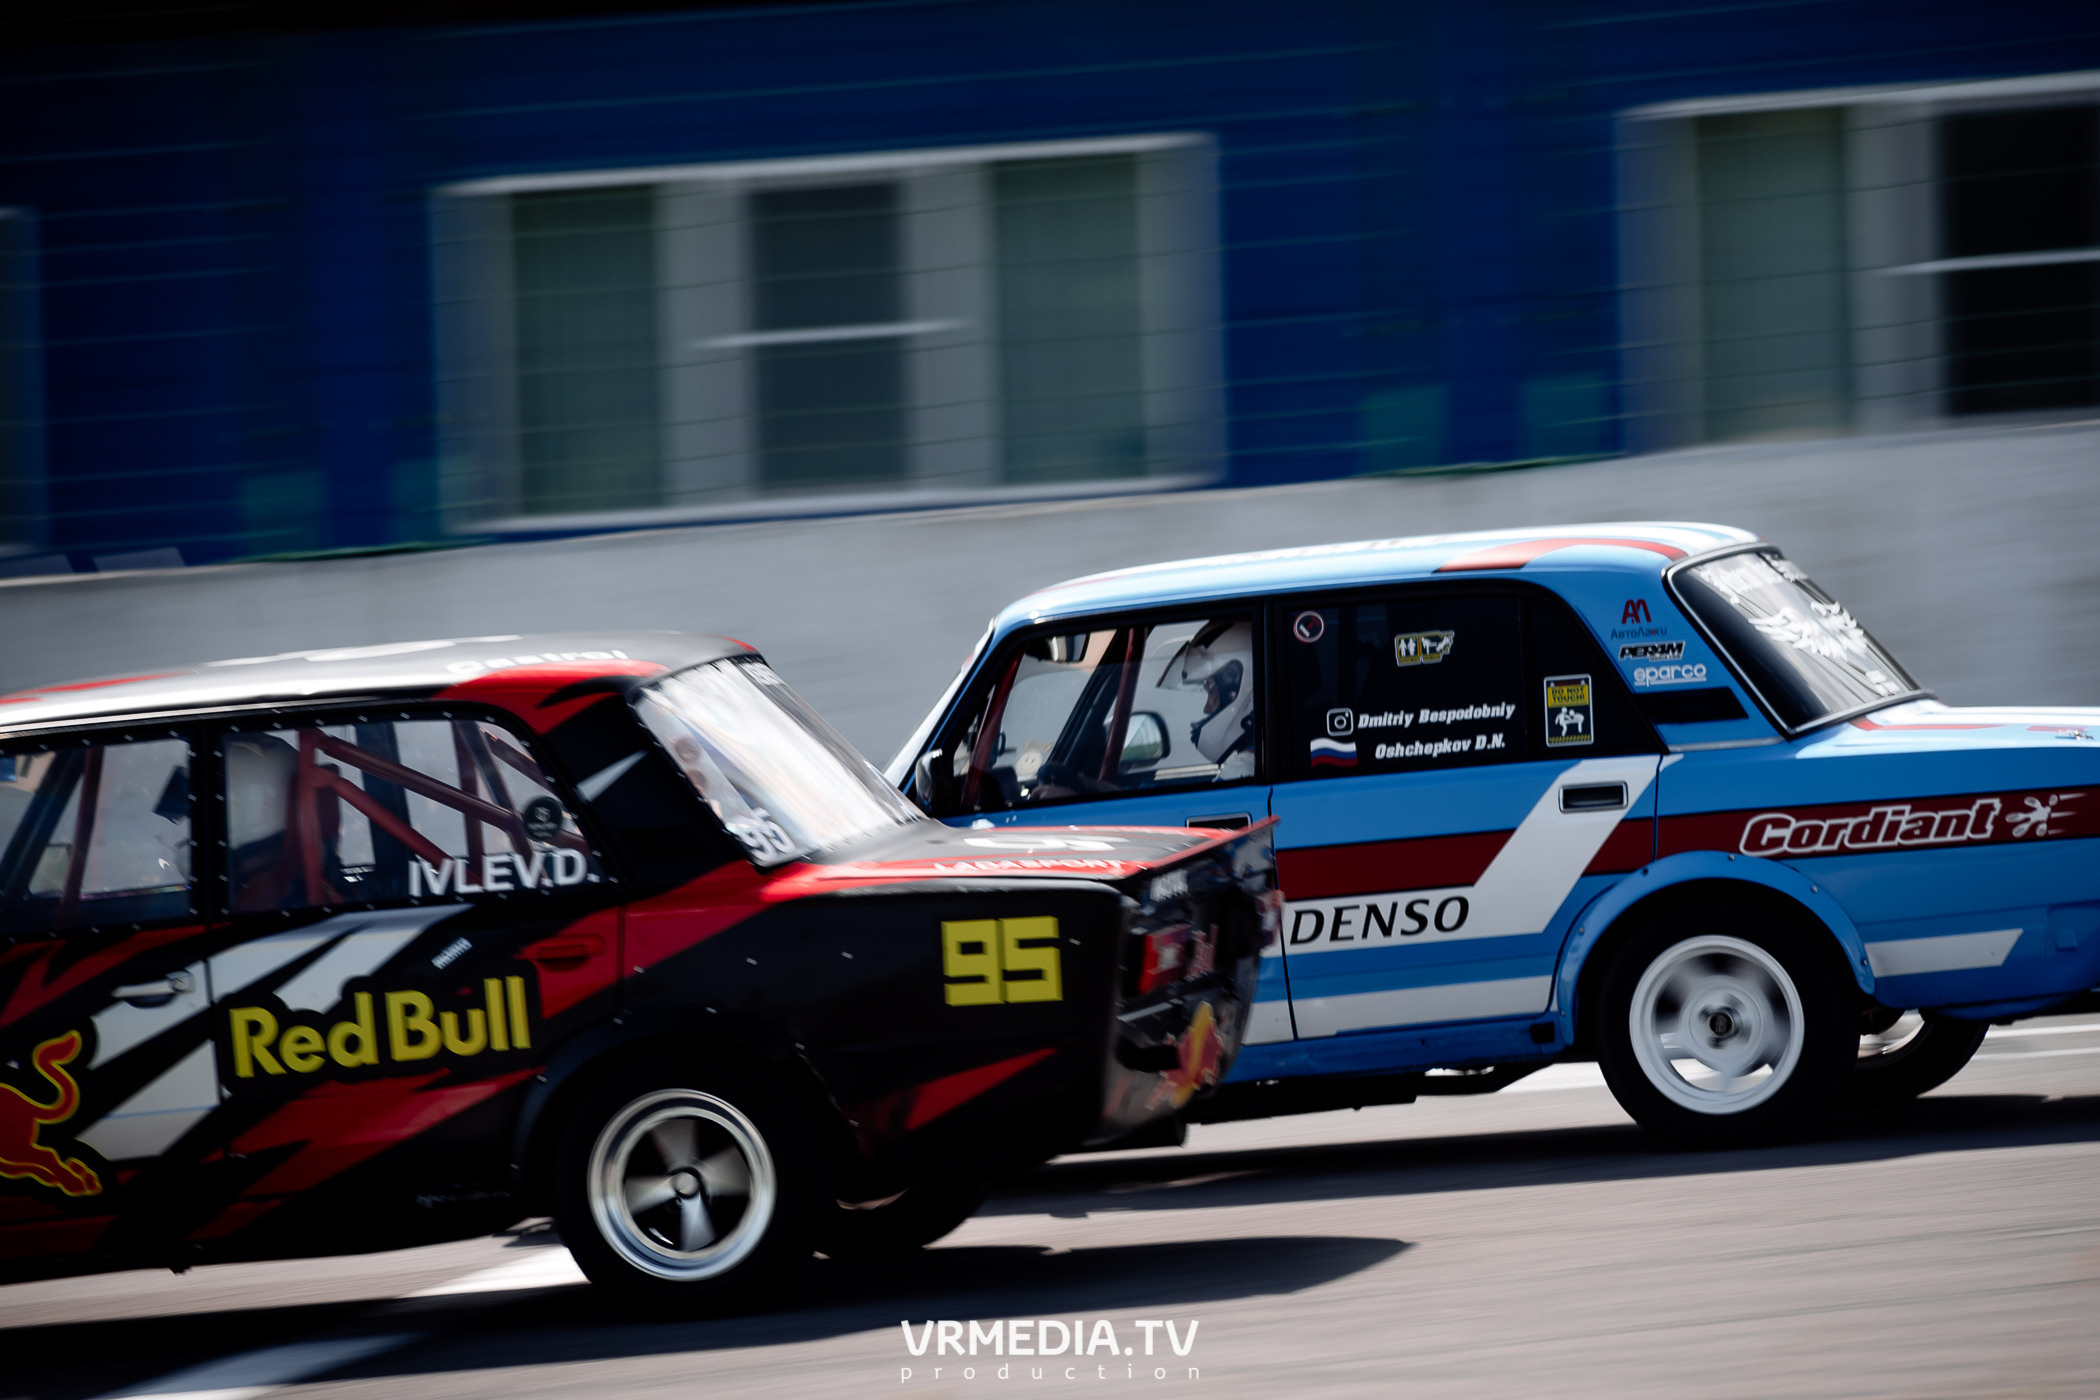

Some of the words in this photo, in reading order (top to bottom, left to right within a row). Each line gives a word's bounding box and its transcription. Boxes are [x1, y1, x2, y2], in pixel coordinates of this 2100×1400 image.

[1633, 663, 1707, 688] sparco
[1358, 710, 1414, 729] Dmitriy
[1418, 701, 1516, 725] Bespodobniy
[1375, 737, 1471, 760] Oshchepkov
[1474, 732, 1505, 752] D.N.
[1739, 797, 2001, 857] Cordiant
[1289, 896, 1470, 946] DENSO
[940, 914, 1063, 1007] 95
[229, 991, 379, 1078] Red
[385, 974, 531, 1062] Bull
